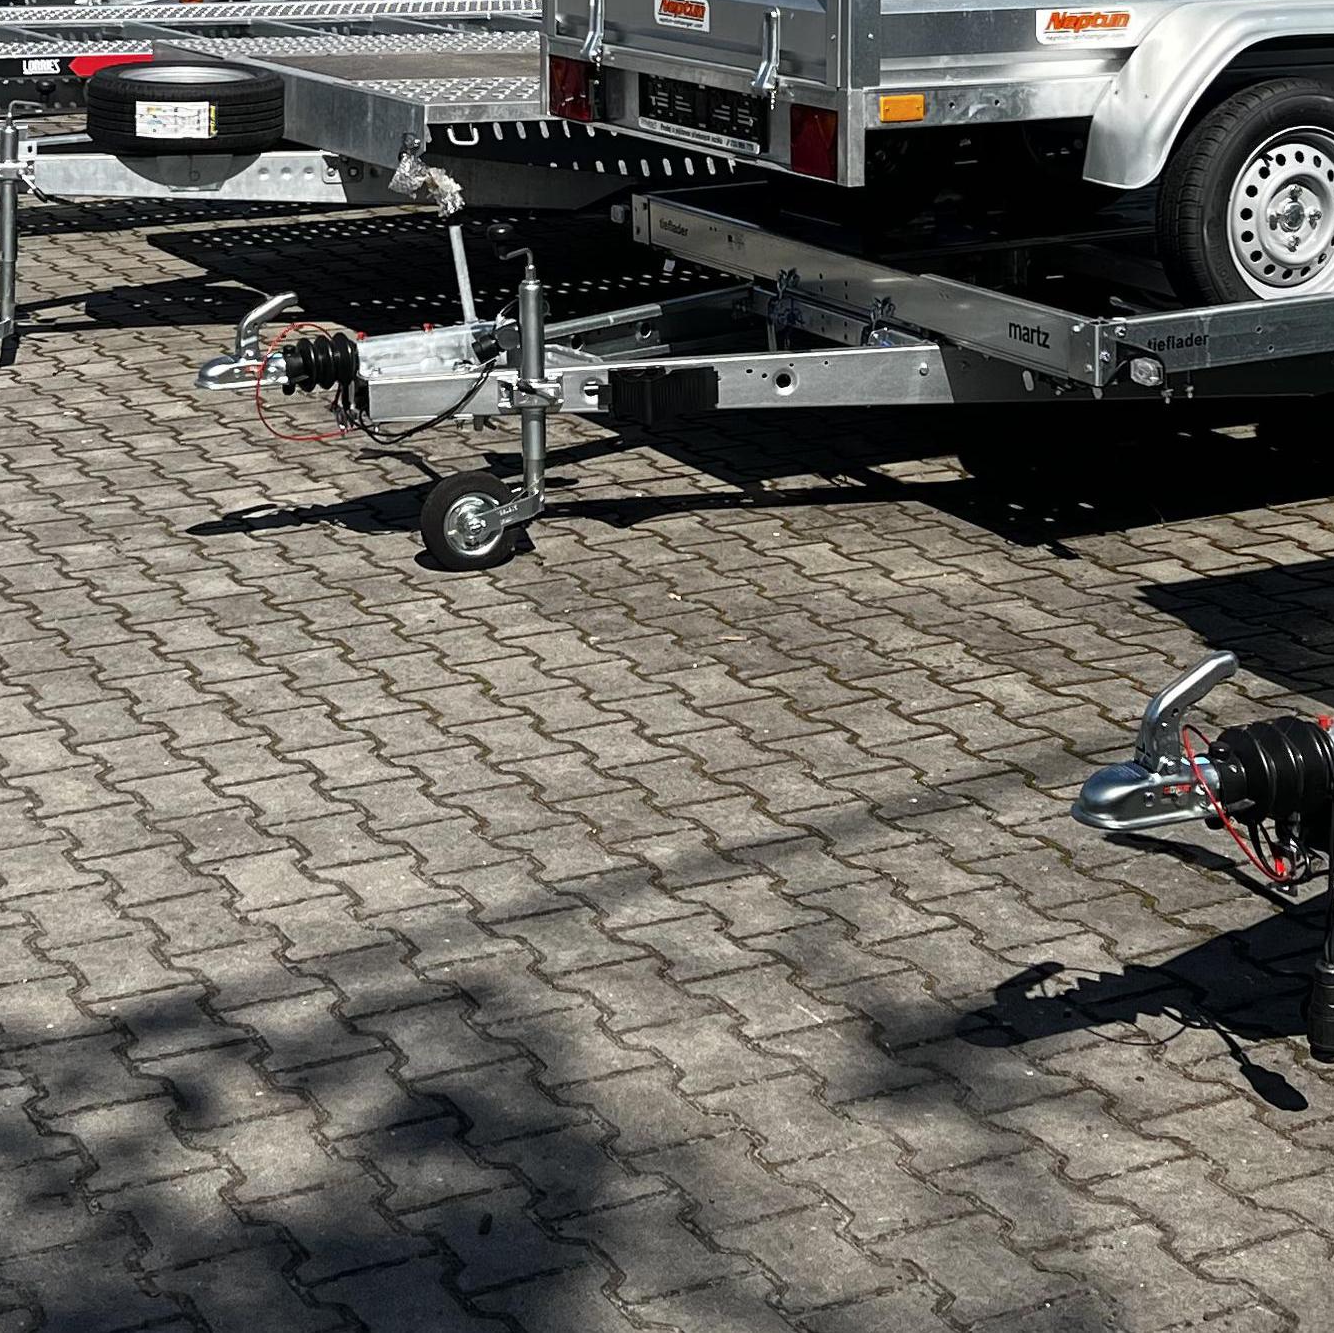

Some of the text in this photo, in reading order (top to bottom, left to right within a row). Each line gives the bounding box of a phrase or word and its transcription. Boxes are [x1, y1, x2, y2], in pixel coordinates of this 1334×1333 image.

[1045, 11, 1131, 33] Neptun
[22, 58, 61, 76] LORRIES
[1008, 322, 1051, 349] martz
